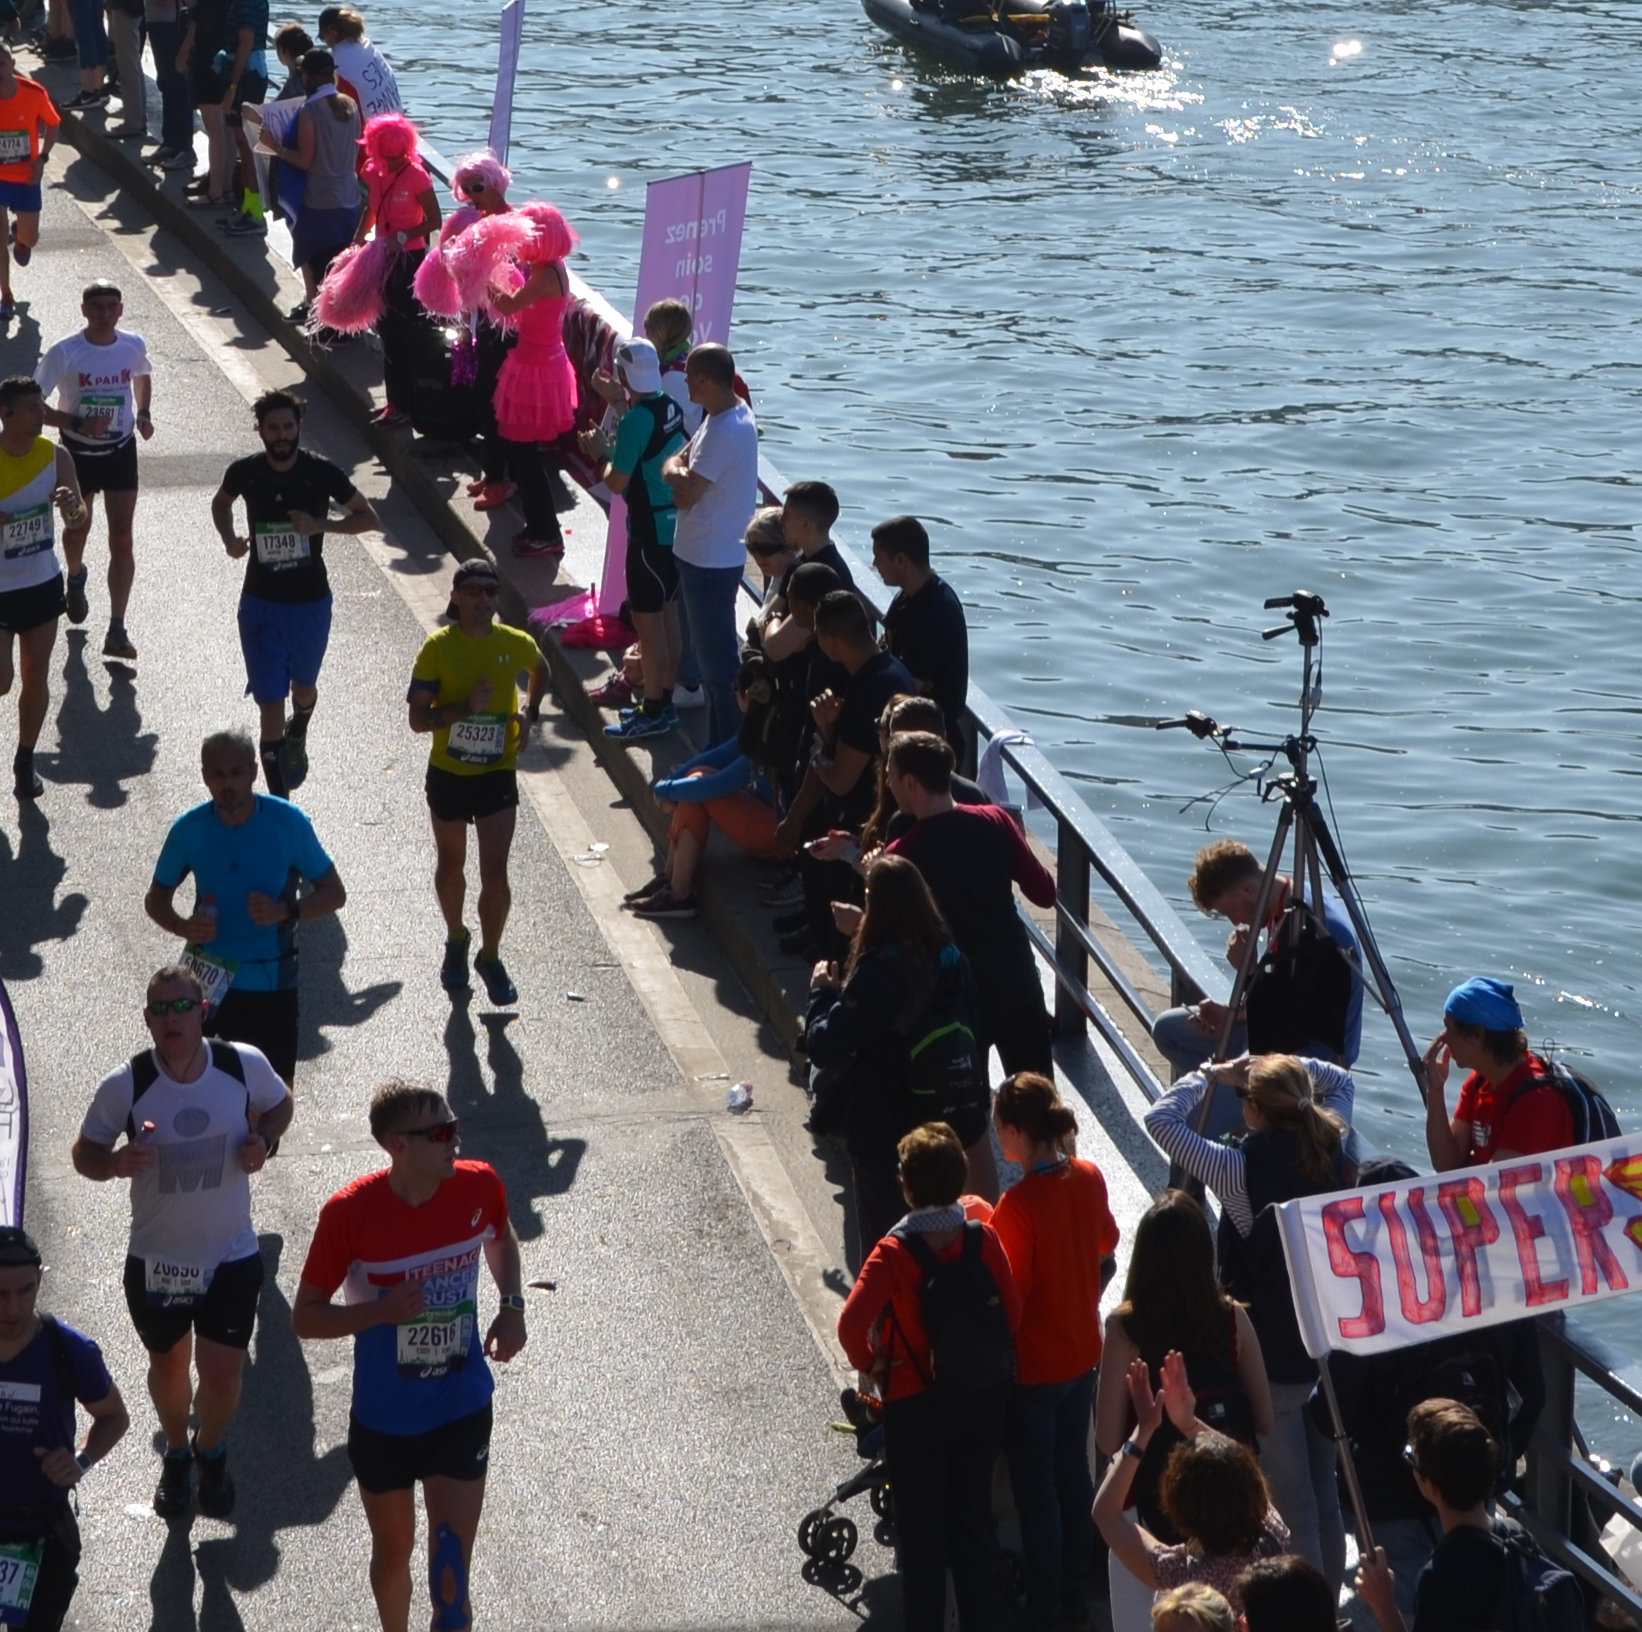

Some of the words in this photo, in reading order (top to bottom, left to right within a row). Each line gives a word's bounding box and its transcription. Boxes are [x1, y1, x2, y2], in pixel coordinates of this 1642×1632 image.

[95, 375, 119, 385] PAR
[9, 518, 41, 539] 22749
[263, 534, 295, 549] 17348
[456, 724, 495, 742] 25323
[1321, 1158, 1629, 1341] SUPER
[410, 1252, 479, 1277] TEENAG
[423, 1268, 477, 1288] ANCER
[423, 1288, 468, 1305] RUST
[420, 1310, 457, 1323] chneider
[407, 1324, 456, 1346] 22616
